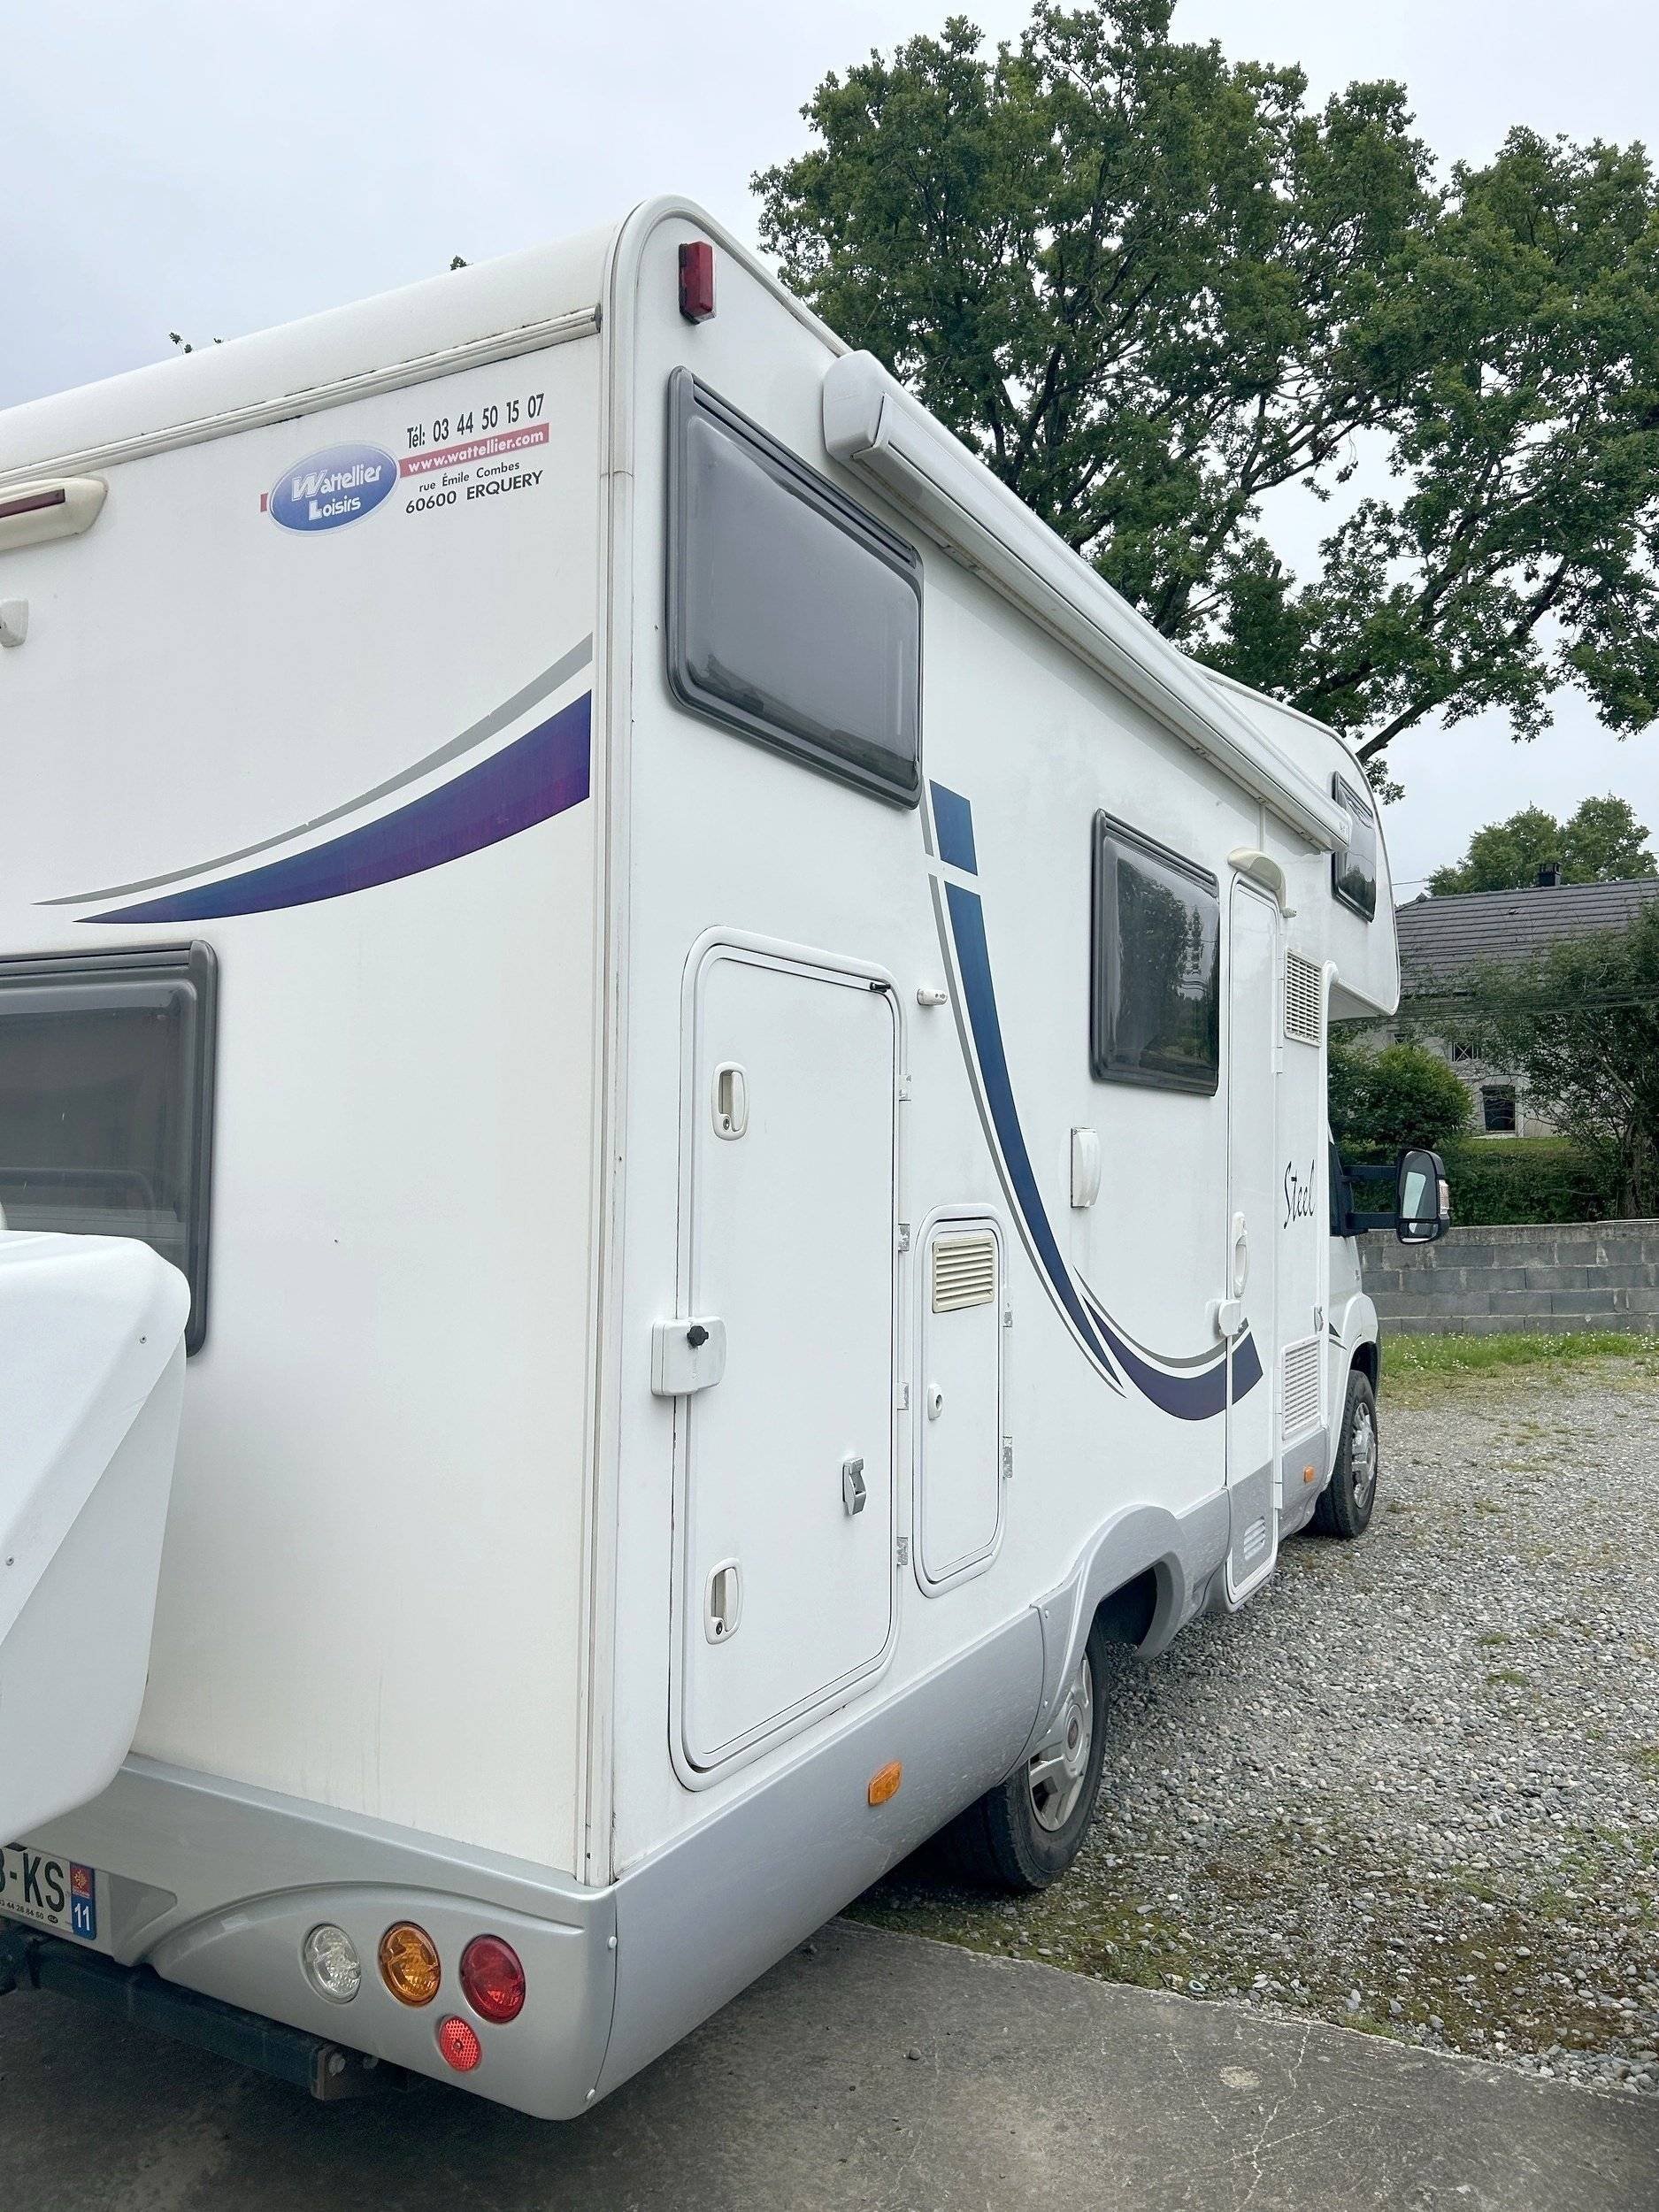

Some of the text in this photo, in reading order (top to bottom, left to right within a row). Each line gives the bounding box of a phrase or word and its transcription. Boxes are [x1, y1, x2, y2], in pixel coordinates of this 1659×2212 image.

[407, 393, 544, 449] Tél: 03 44 50 15 07
[408, 431, 544, 473] www.wattellier.com
[291, 464, 382, 502] Wattellier
[405, 470, 543, 514] 60600 ERQUERY
[419, 461, 519, 493] rue Émile Combes
[308, 495, 362, 520] Loisirs
[1283, 1159, 1316, 1230] Steel
[74, 1902, 90, 1931] 11
